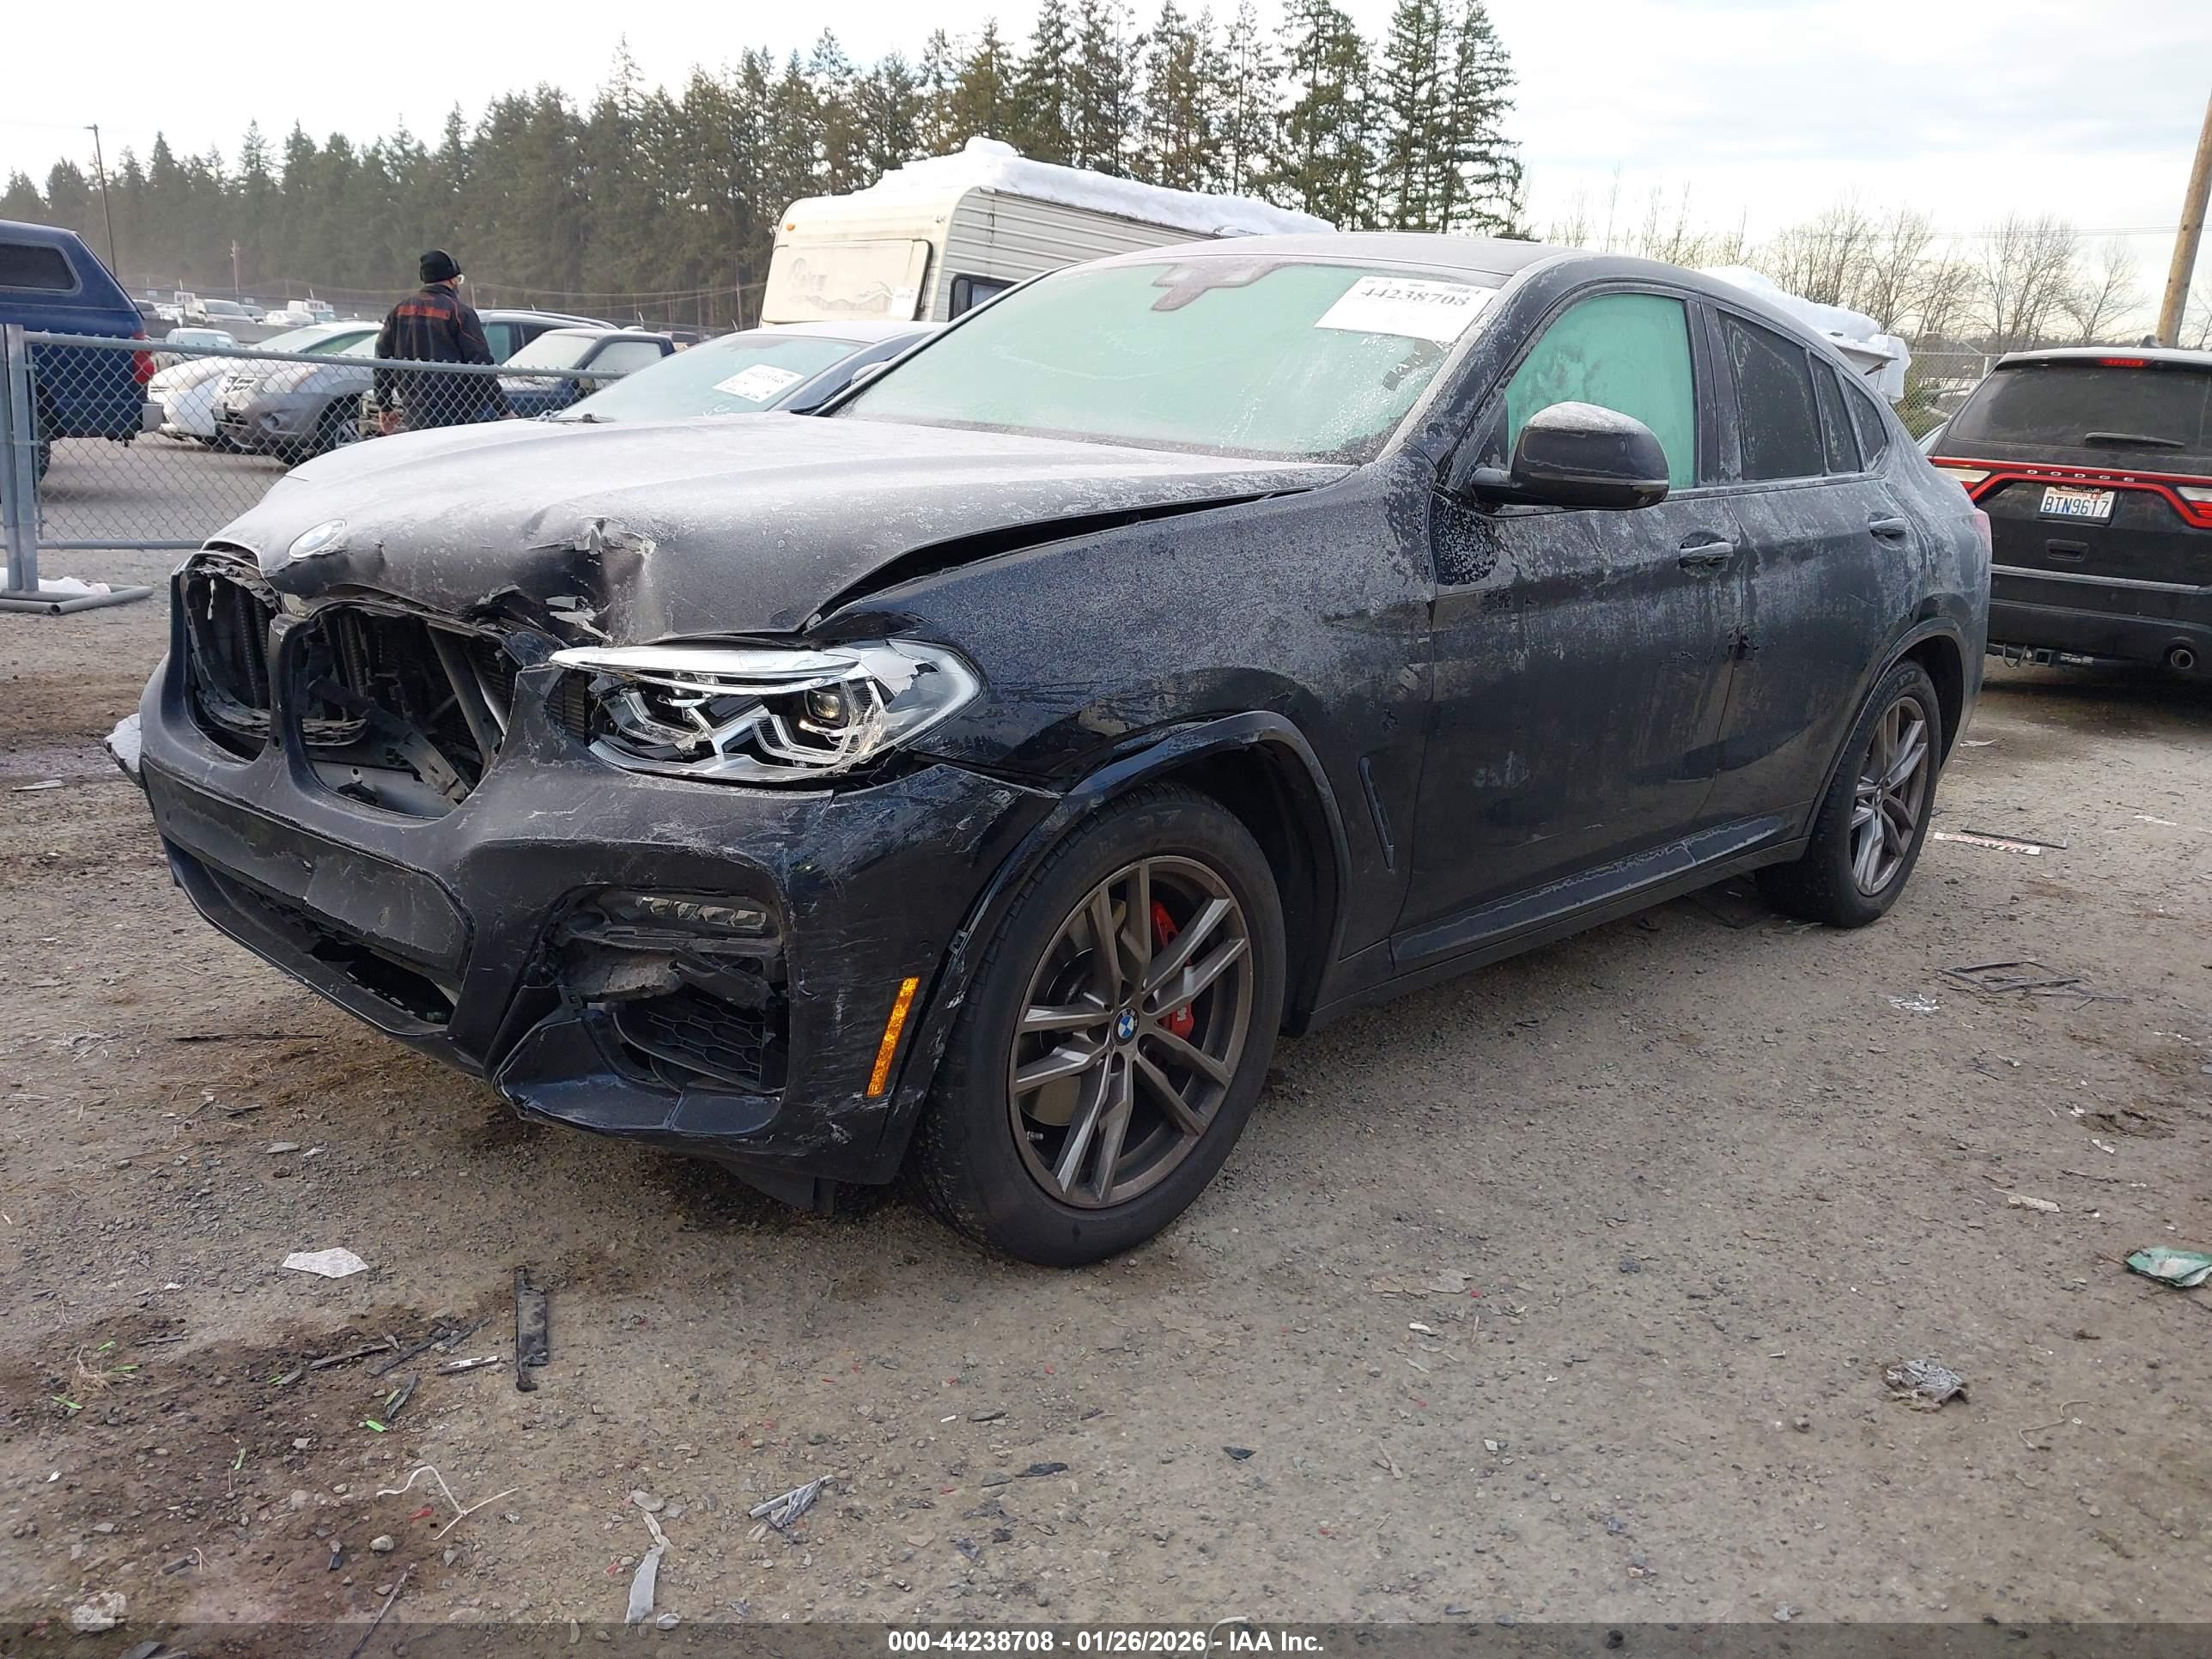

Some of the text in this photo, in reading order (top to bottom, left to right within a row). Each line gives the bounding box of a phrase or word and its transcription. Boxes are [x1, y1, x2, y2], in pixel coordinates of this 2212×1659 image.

[1360, 289, 1470, 306] 44238708
[2027, 469, 2135, 483] DODGE
[2044, 496, 2109, 515] BTN9617
